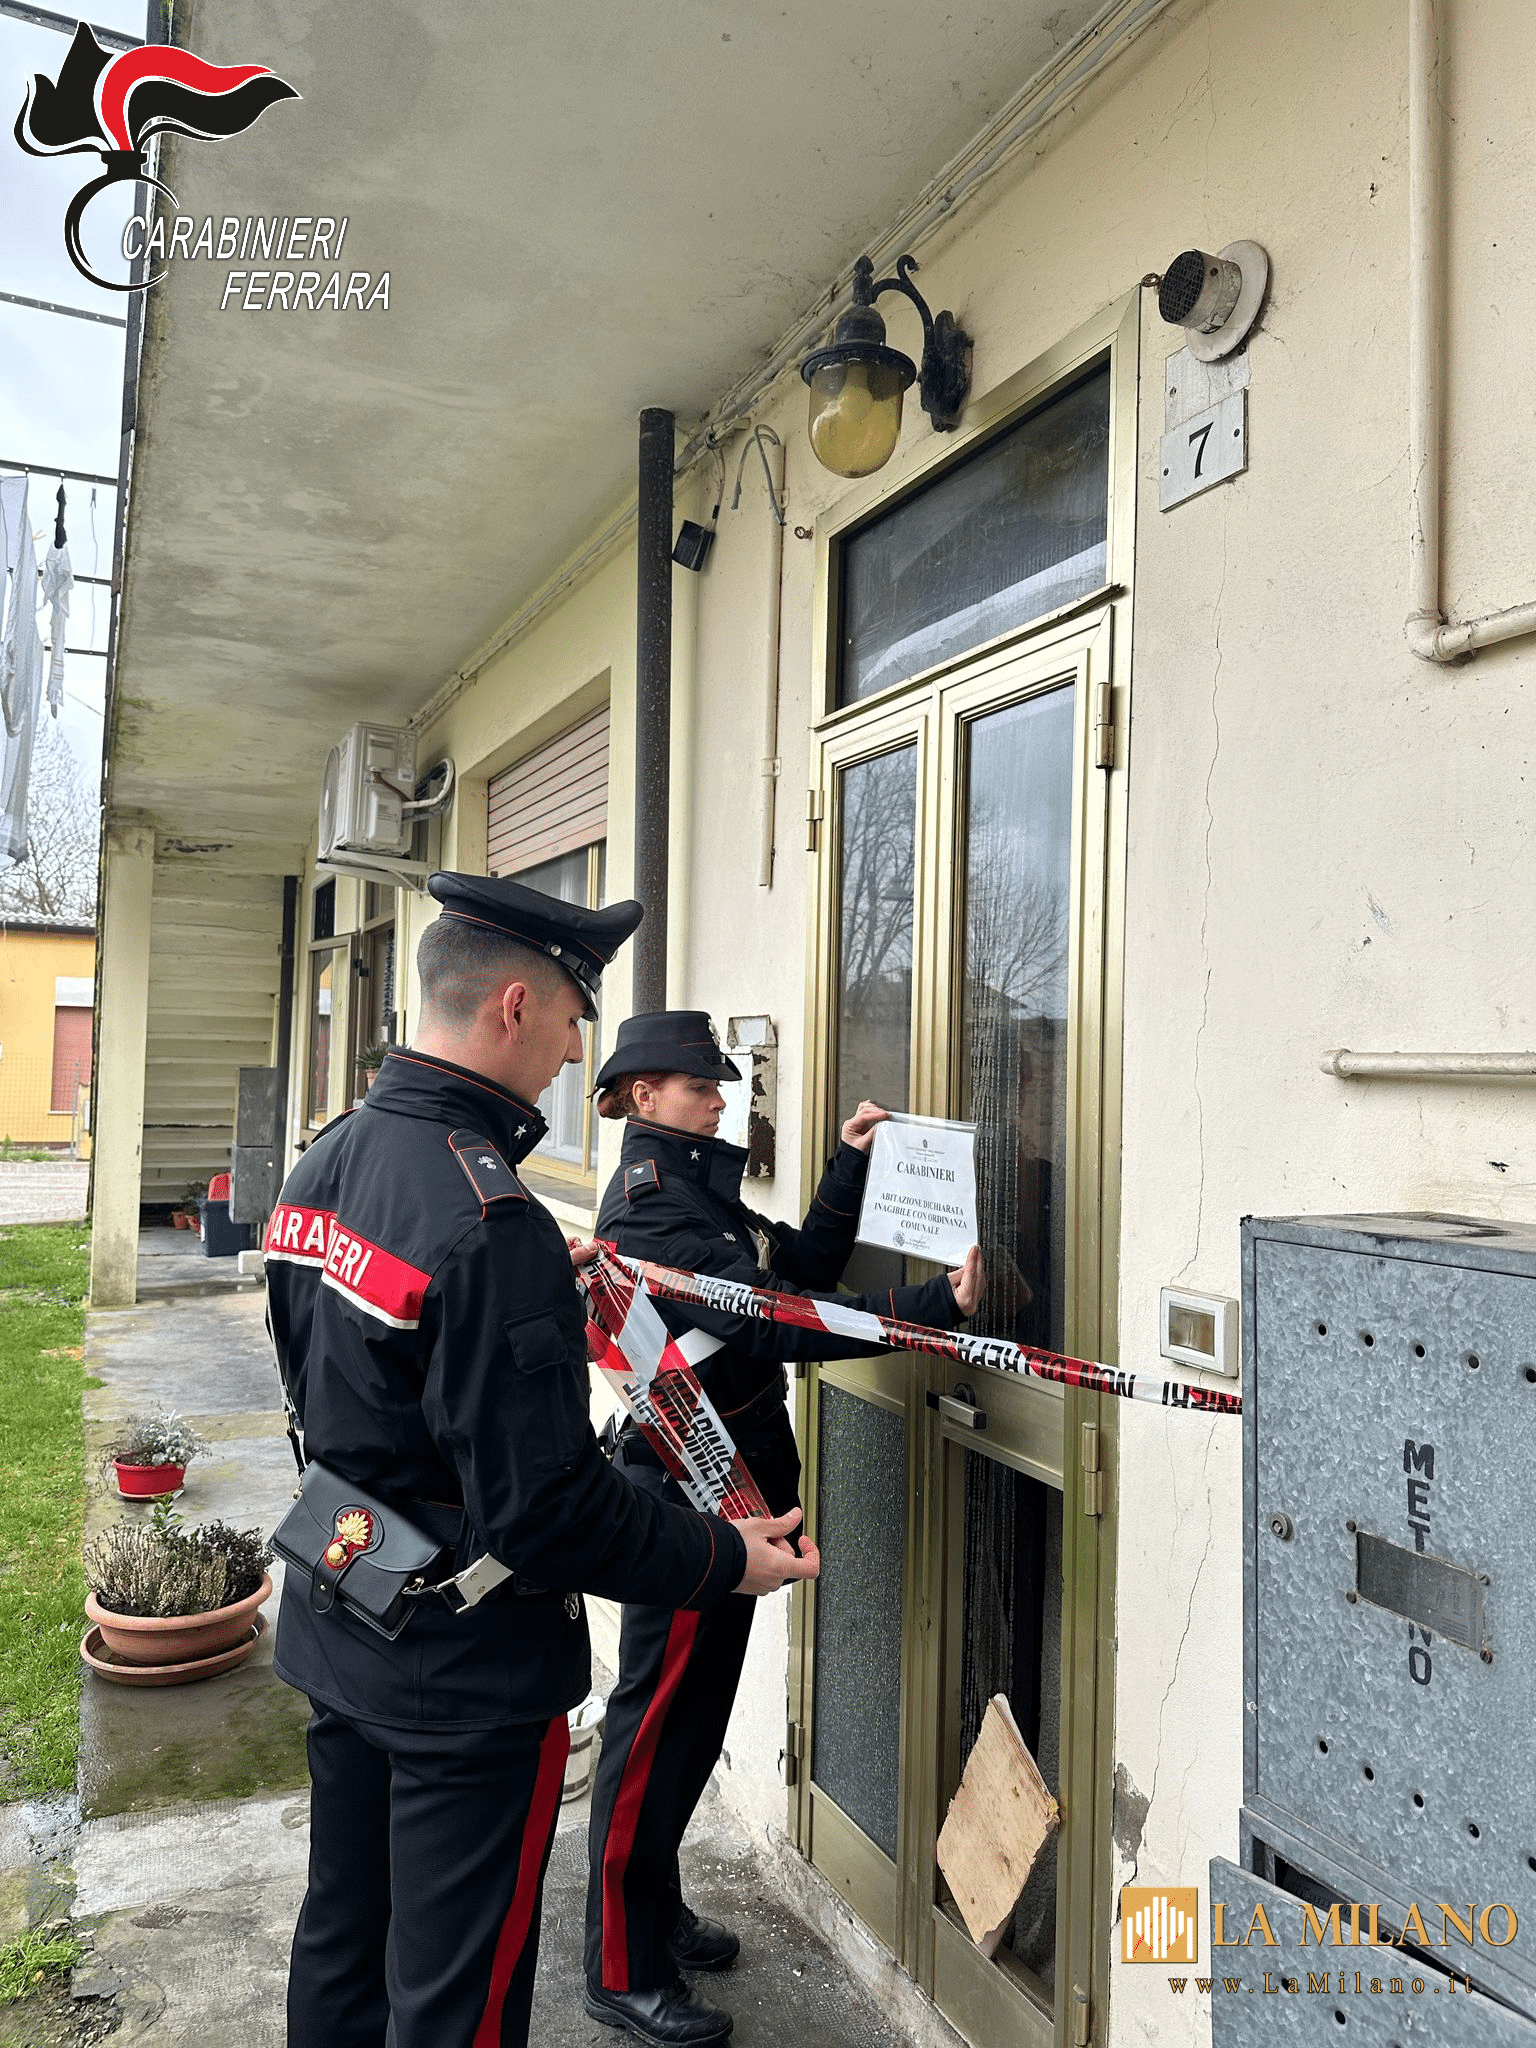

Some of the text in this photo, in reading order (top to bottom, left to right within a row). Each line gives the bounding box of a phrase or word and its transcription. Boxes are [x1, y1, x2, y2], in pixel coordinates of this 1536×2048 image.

[1188, 421, 1215, 480] 7
[896, 1161, 956, 1183] CARABINIERI
[874, 1202, 968, 1230] INAGIBILE CON ORDINANZA
[880, 1192, 964, 1217] ABITAZIONE DICHIARATA
[900, 1219, 940, 1236] COMUNALE
